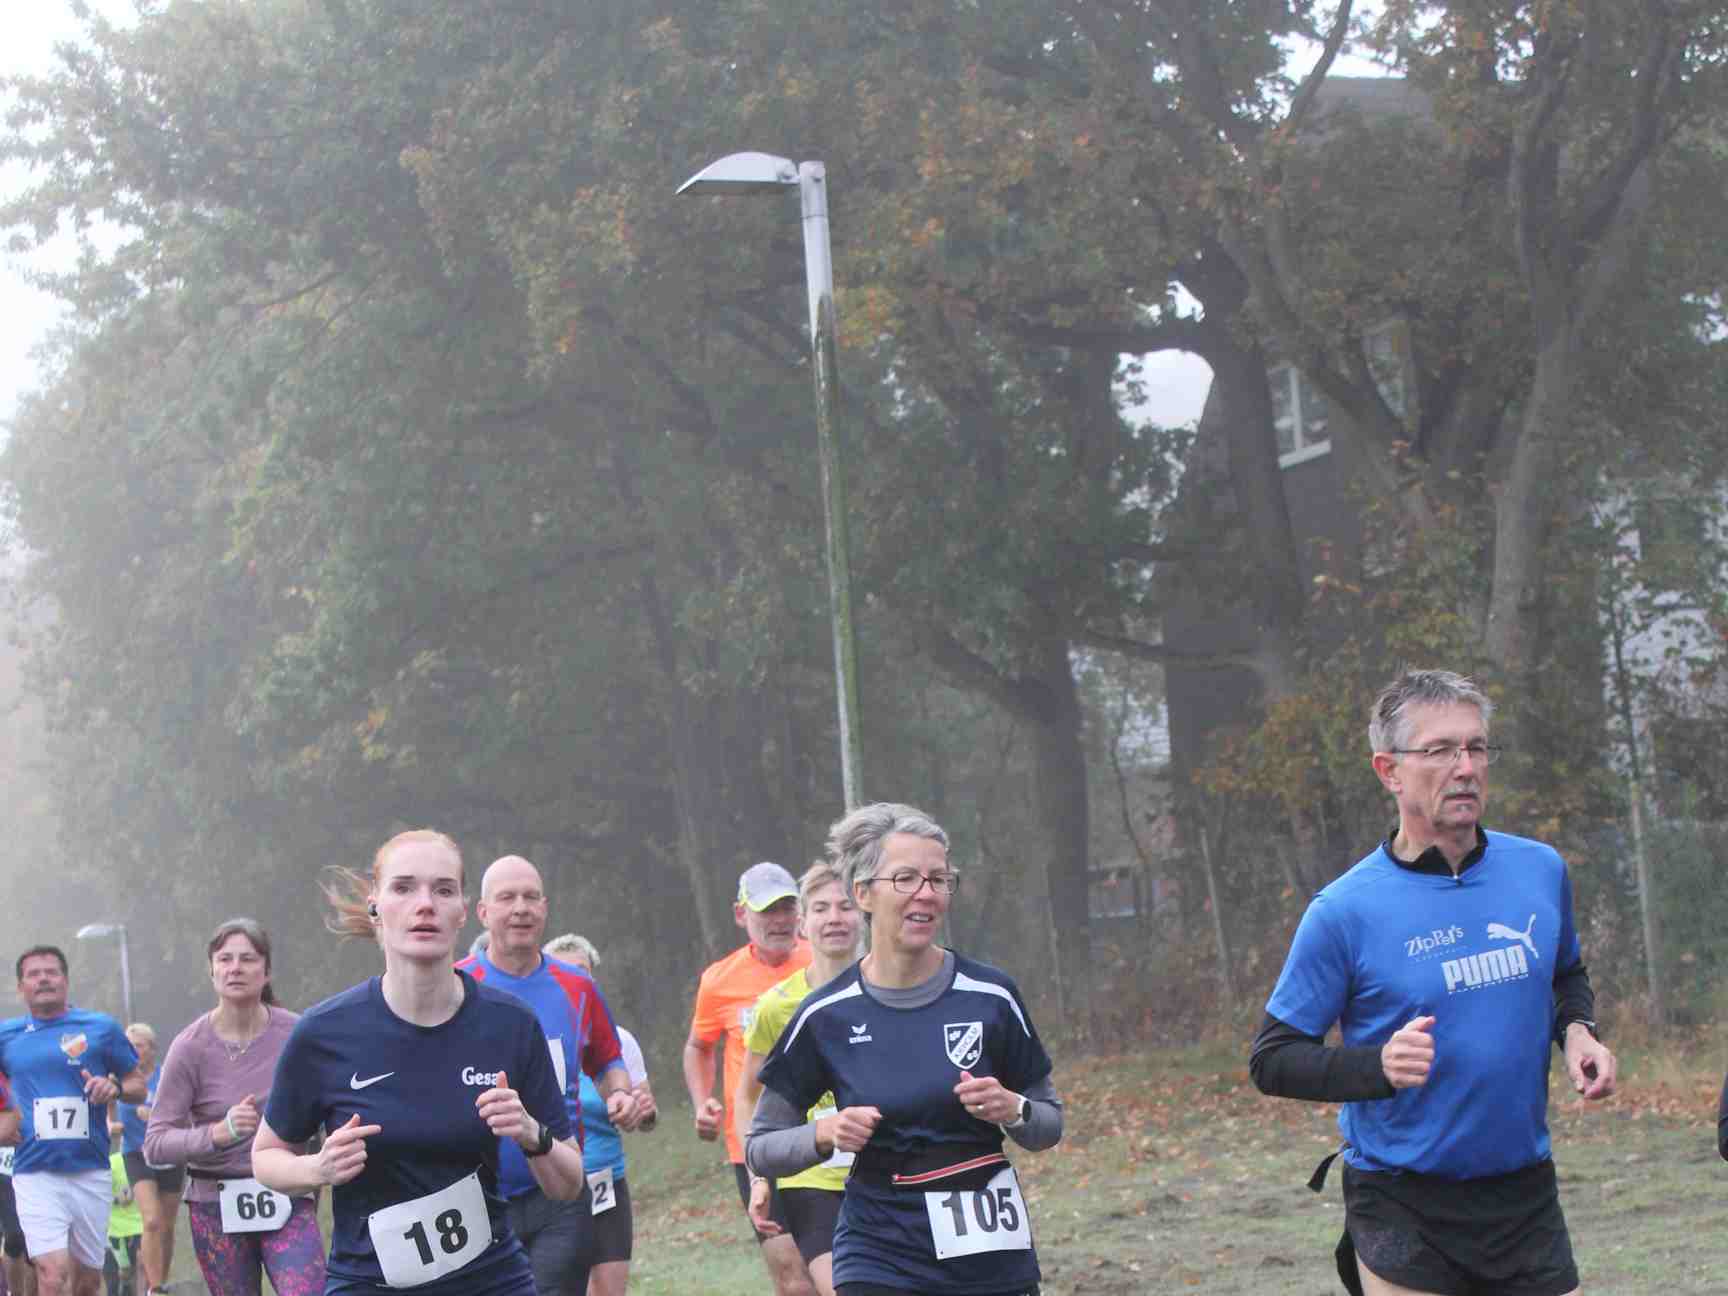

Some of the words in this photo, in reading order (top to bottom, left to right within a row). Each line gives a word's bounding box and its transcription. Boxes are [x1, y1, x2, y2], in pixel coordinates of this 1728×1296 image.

[1441, 944, 1529, 993] PUMA
[48, 1108, 78, 1129] 17
[236, 1190, 277, 1220] 66
[941, 1187, 1020, 1237] 105
[403, 1208, 469, 1266] 18
